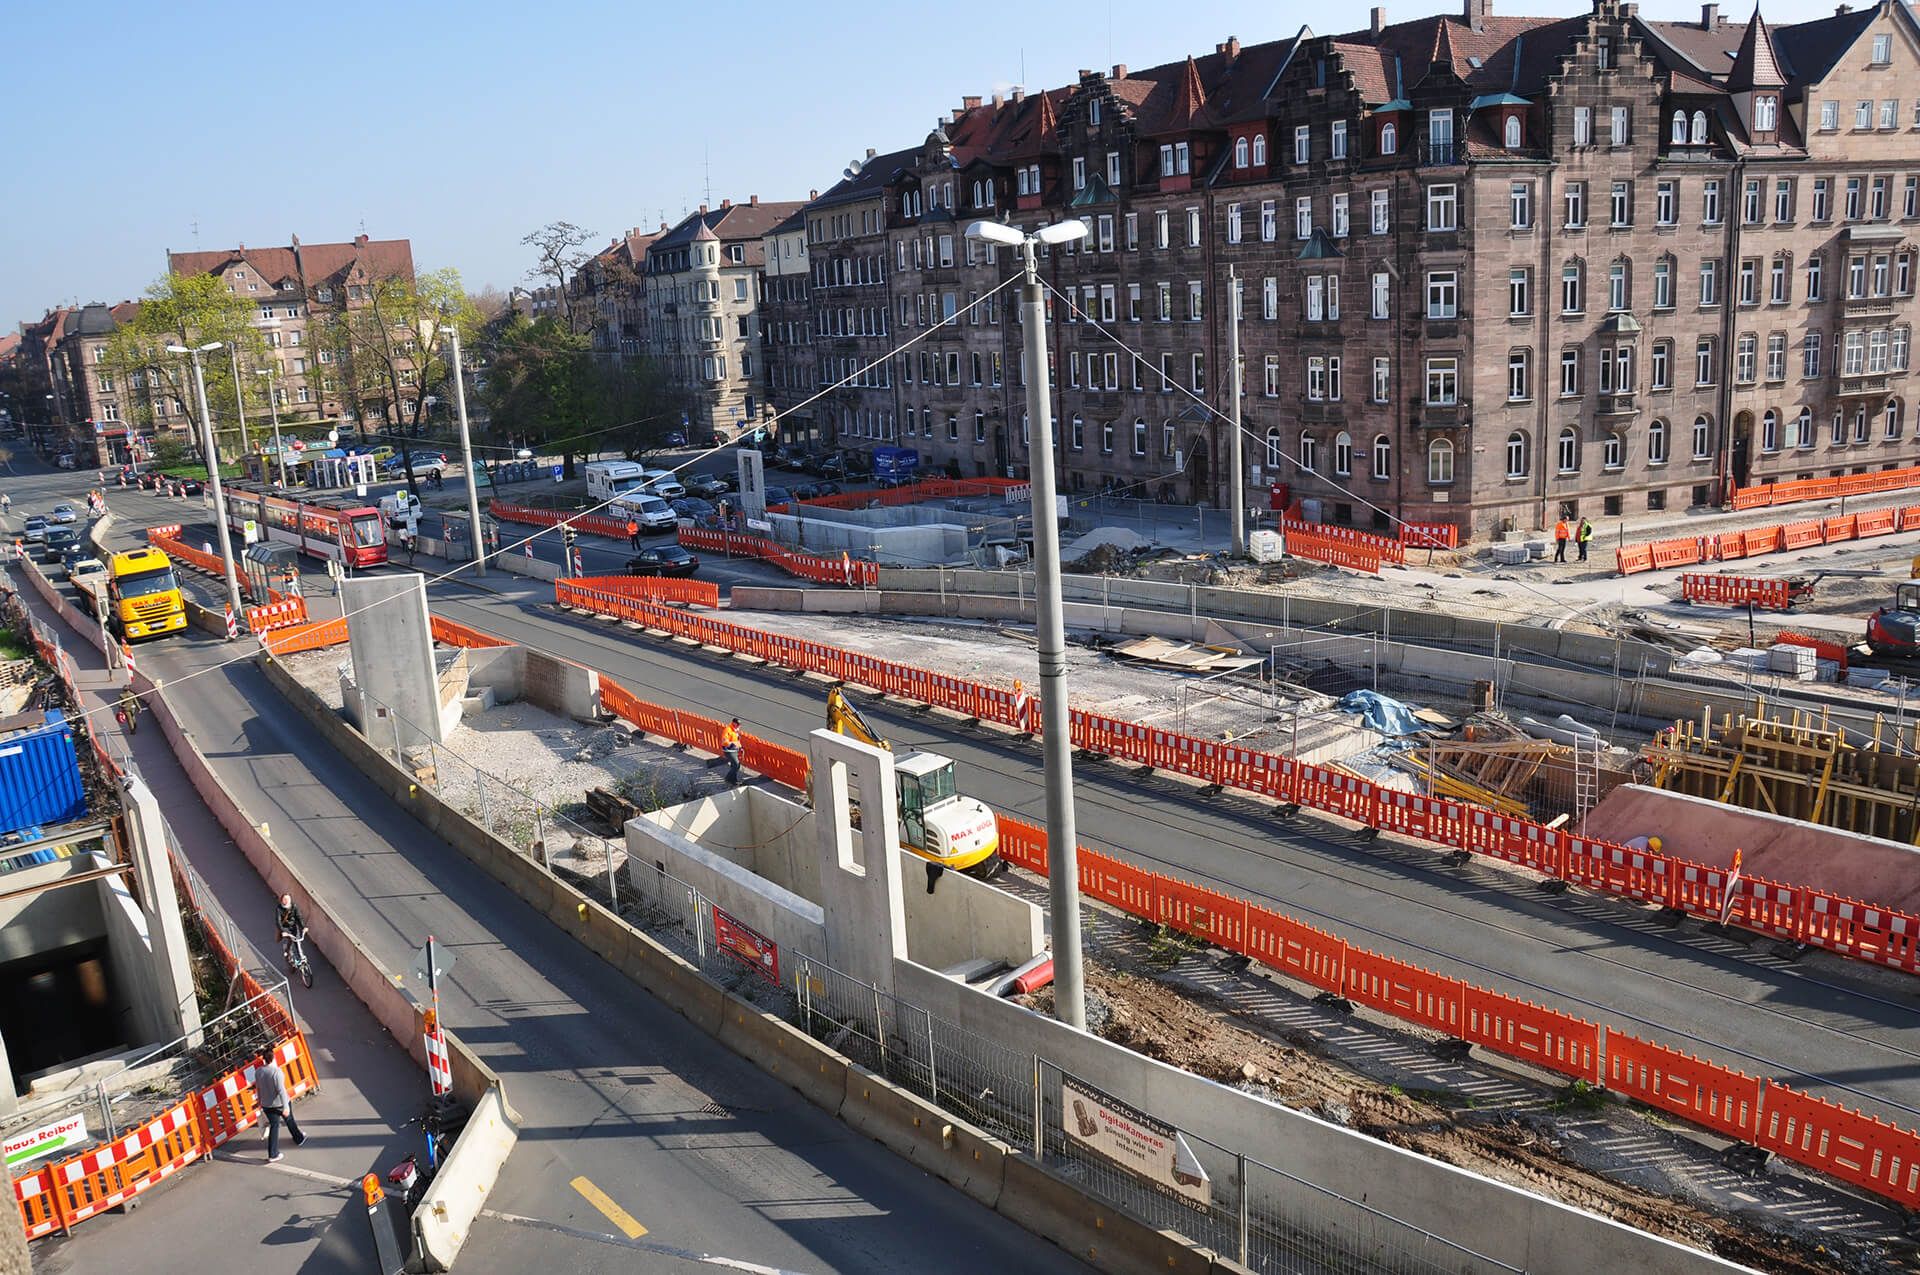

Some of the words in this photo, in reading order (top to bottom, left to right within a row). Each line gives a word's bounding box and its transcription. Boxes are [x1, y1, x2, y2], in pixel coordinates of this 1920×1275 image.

[951, 829, 973, 841] MAX
[5, 1138, 35, 1153] haus
[38, 1121, 79, 1141] Reiber
[1099, 1109, 1164, 1150] Digitalkameras
[1104, 1125, 1132, 1146] günstig
[1132, 1138, 1150, 1151] wie
[1148, 1147, 1158, 1157] im
[1115, 1140, 1145, 1161] Internet
